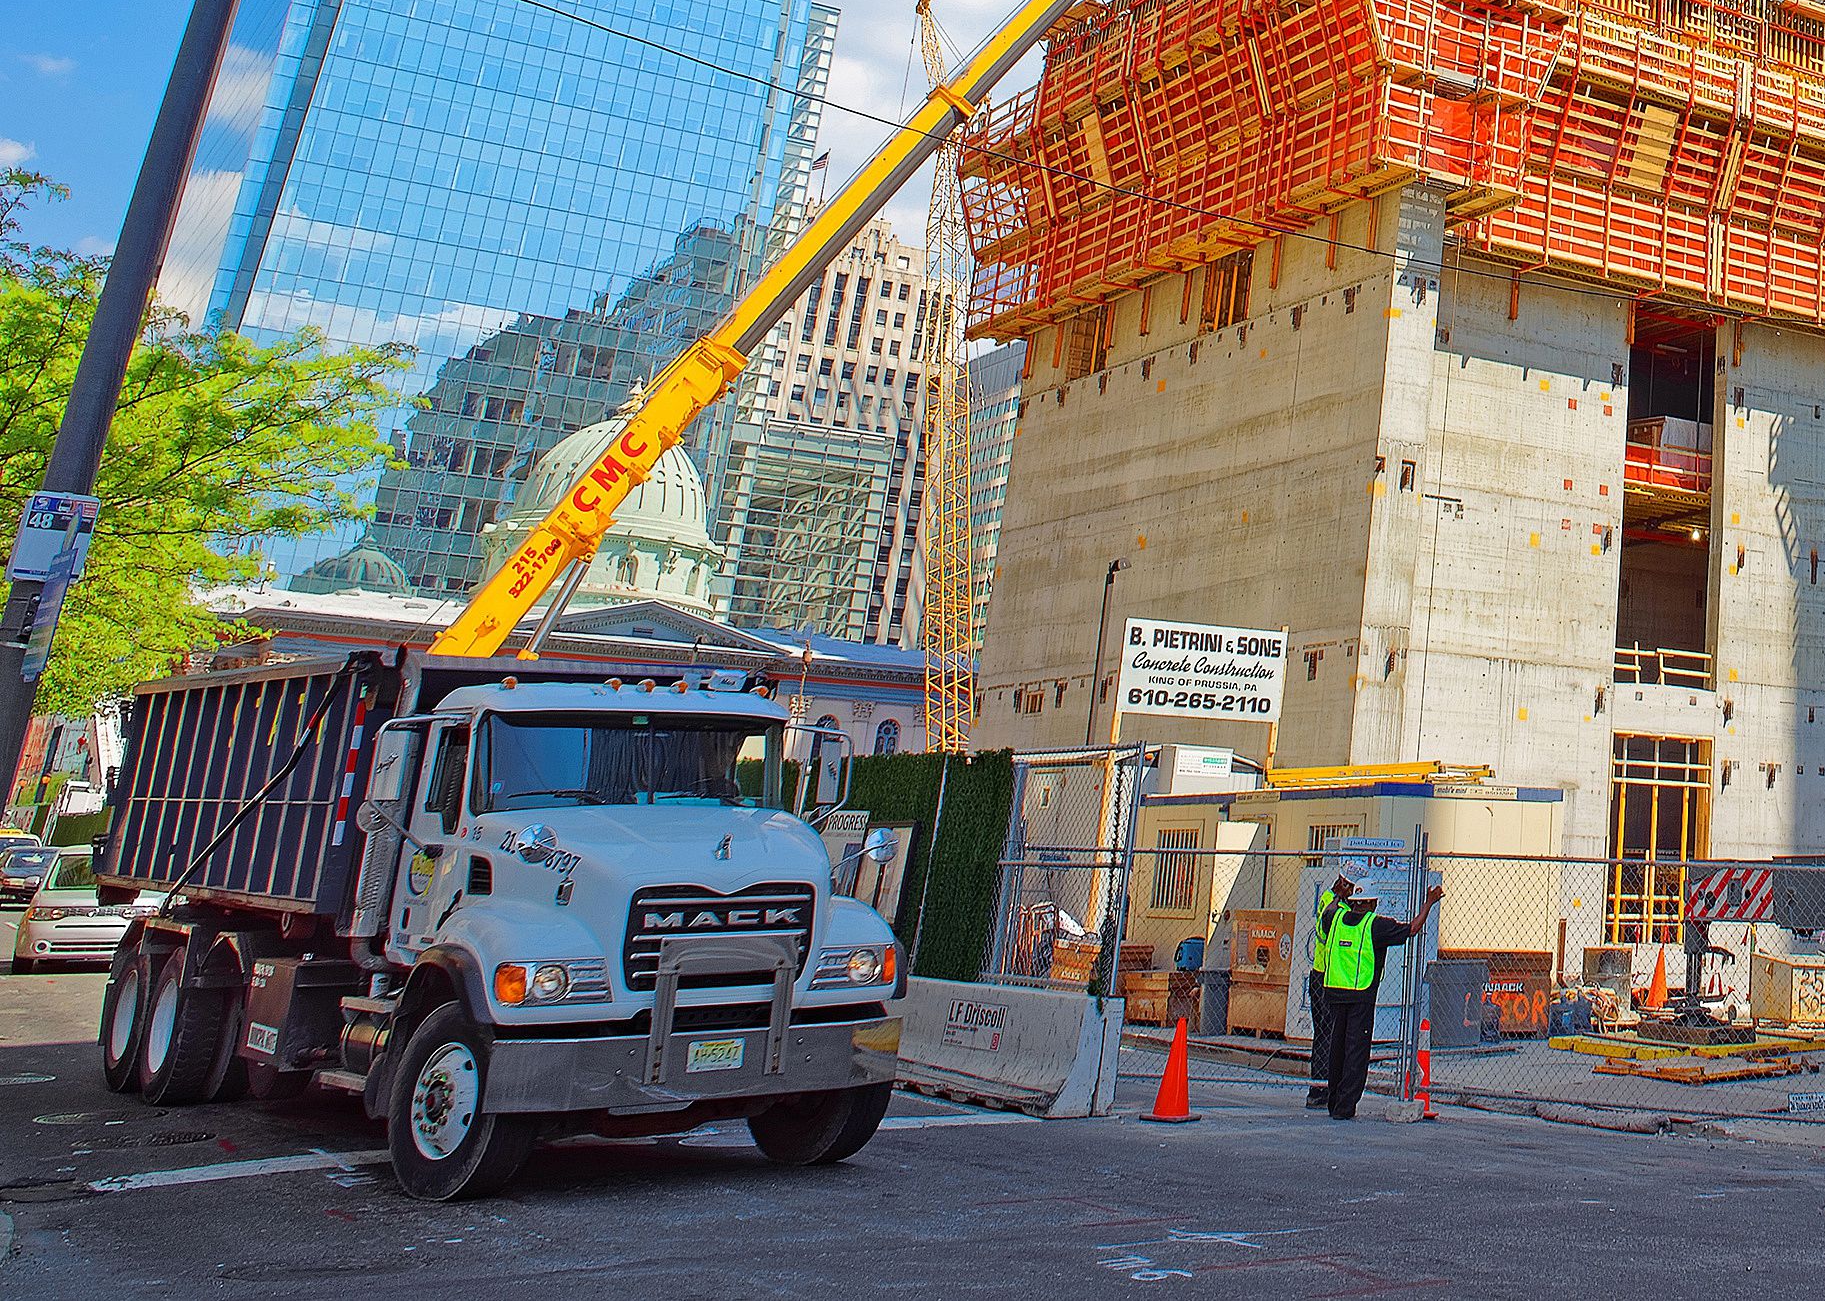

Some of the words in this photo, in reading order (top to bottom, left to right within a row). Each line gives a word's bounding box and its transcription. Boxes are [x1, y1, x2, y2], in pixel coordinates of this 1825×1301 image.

[573, 432, 647, 512] CMC
[29, 511, 53, 529] 48
[512, 547, 537, 574] 215
[1130, 627, 1147, 647] B.
[1153, 628, 1223, 653] PIETRINI
[1226, 640, 1234, 654] &
[1236, 636, 1282, 658] SONS
[1132, 651, 1192, 672] Concrete
[1193, 656, 1275, 680] Construction
[1148, 676, 1175, 685] KING
[1177, 678, 1192, 686] OF
[1194, 679, 1241, 692] PRUSSIA,
[1244, 683, 1257, 692] PA
[1128, 688, 1271, 714] 610-265-2110
[644, 908, 802, 929] MACK
[948, 1001, 964, 1022] LF
[964, 1002, 1007, 1029] Driscoll
